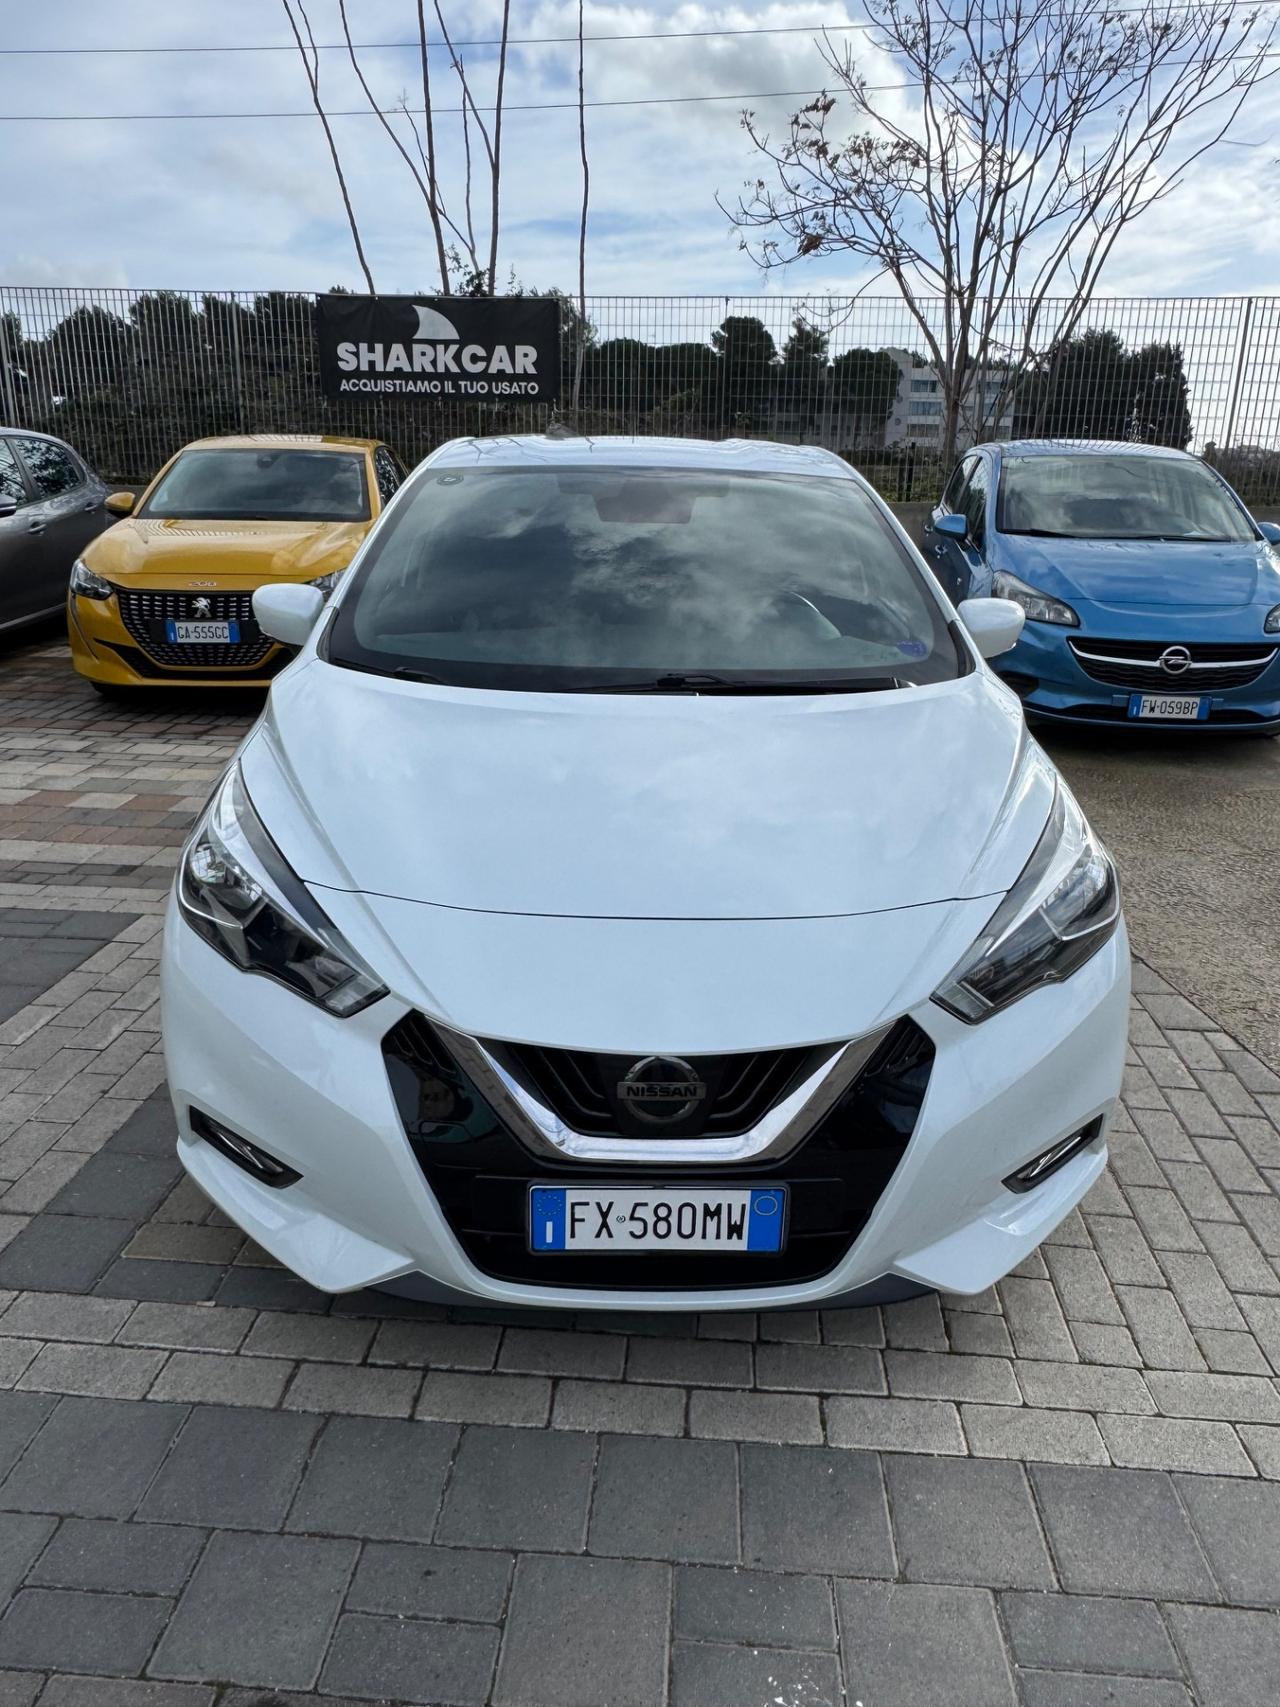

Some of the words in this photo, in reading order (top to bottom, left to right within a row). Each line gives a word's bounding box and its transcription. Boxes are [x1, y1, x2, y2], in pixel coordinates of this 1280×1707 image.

[336, 342, 538, 374] SHARKCAR
[340, 379, 441, 393] ACQUISTIAMO
[444, 381, 456, 393] IL
[458, 381, 489, 394] TUO
[492, 381, 540, 395] USATO
[626, 1086, 698, 1097] NISSAN
